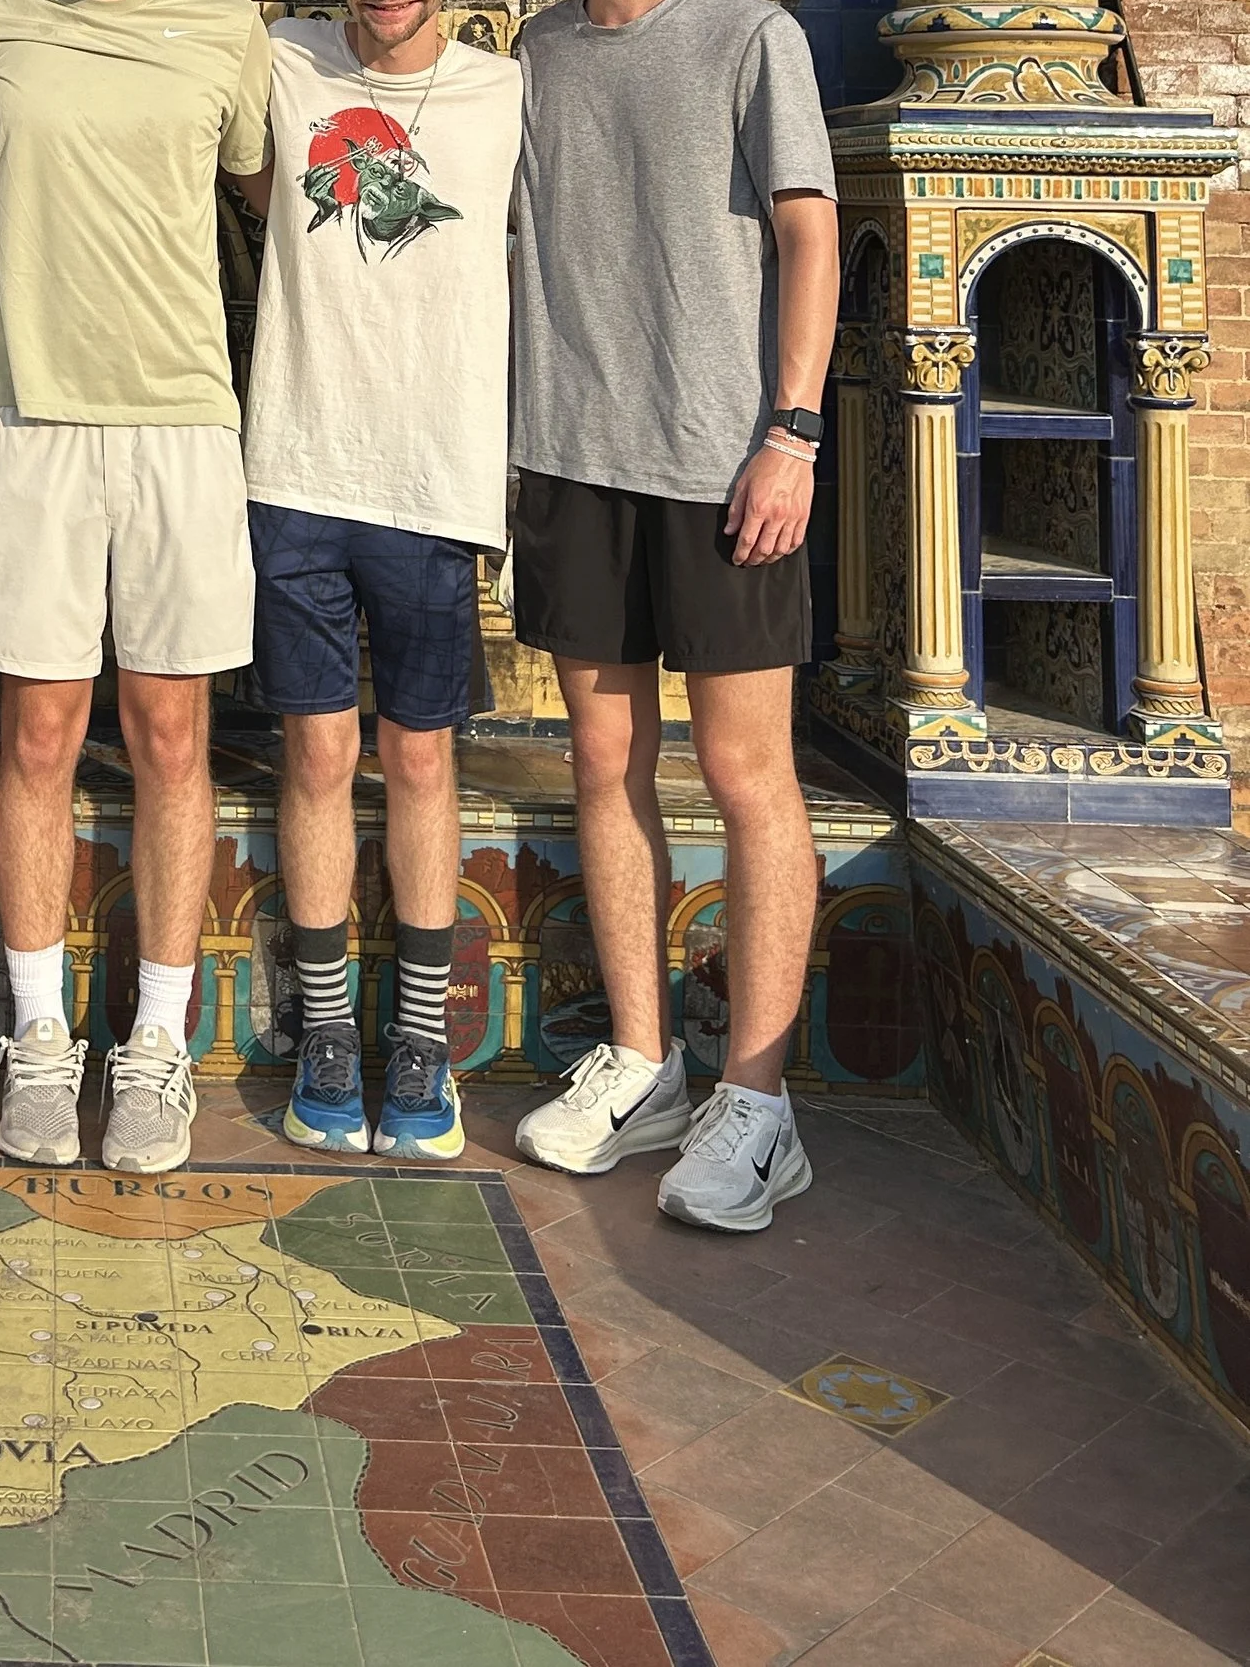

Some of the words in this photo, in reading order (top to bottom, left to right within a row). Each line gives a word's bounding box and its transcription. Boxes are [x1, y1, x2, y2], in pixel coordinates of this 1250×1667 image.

[25, 1175, 273, 1202] BURGOS
[124, 1242, 146, 1250] LA
[326, 1212, 498, 1314] SORIA
[327, 1326, 405, 1339] RIAZA
[220, 1349, 312, 1363] CEREZO
[61, 1385, 180, 1400] PEDRAZA
[52, 1415, 155, 1431] PELAYO
[51, 1450, 309, 1593] MADRID
